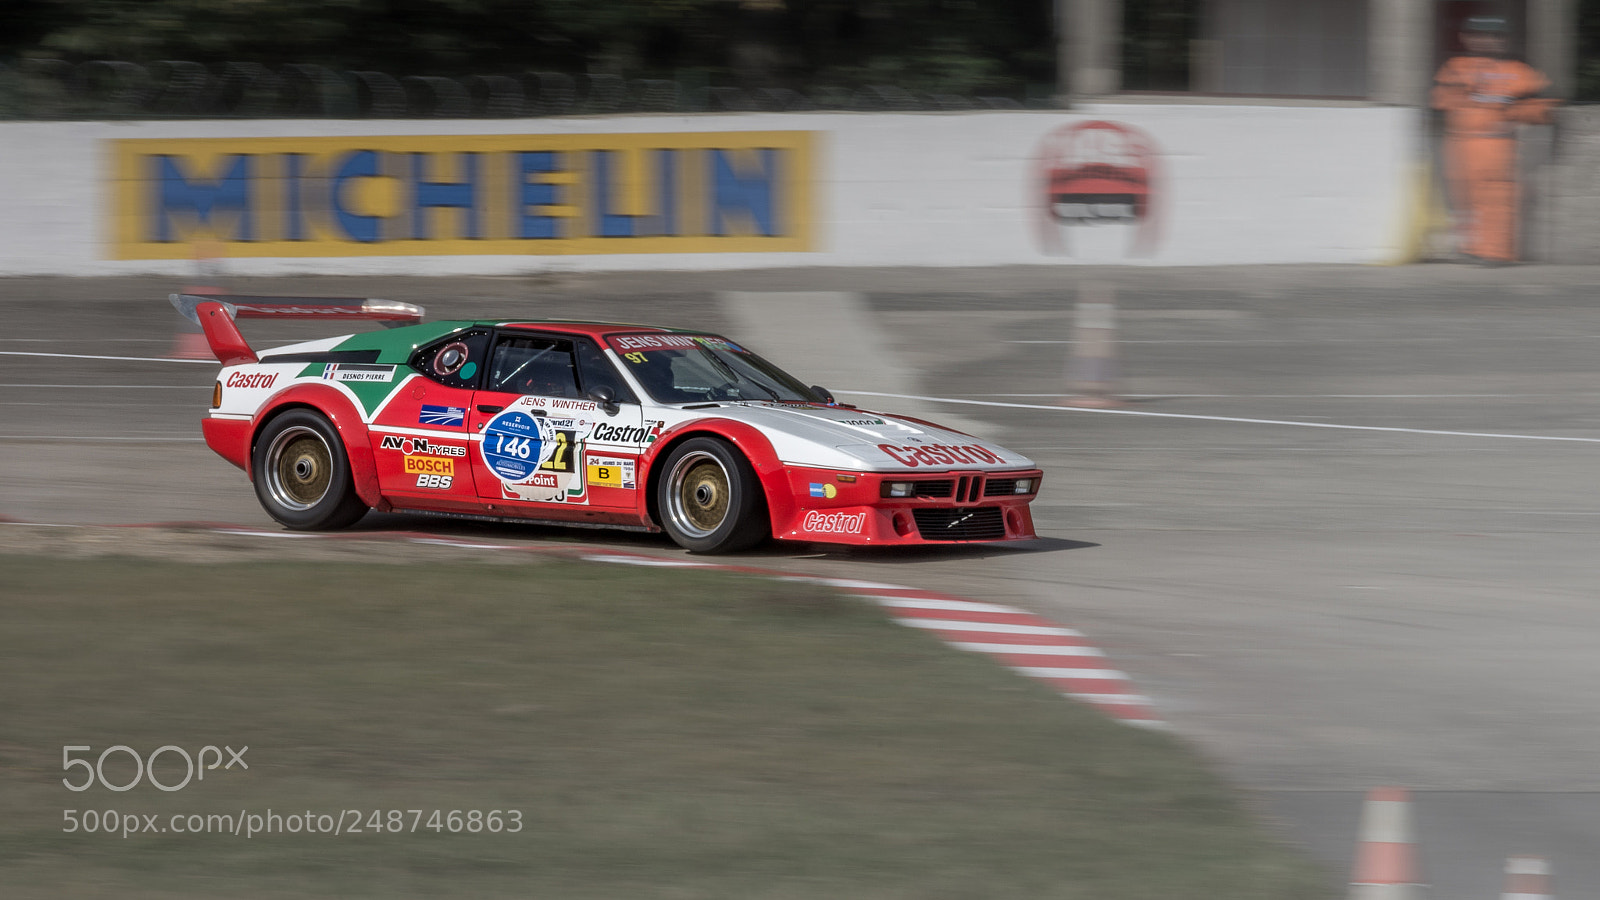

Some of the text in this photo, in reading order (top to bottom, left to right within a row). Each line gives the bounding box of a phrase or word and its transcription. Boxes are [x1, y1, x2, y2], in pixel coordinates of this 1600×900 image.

[145, 148, 787, 244] MICHELIN
[616, 335, 663, 350] JENS
[624, 351, 649, 364] 97
[226, 371, 279, 389] Castrol
[520, 397, 597, 412] JENS WINTHER
[502, 420, 530, 430] RESERVOIR
[593, 423, 652, 443] Castrol
[381, 435, 466, 457] AVON TYRES
[496, 433, 531, 459] 146
[589, 458, 600, 466] 24
[877, 443, 1007, 468] Castrol
[407, 458, 452, 473] BOSCH
[598, 467, 610, 479] B
[416, 473, 453, 489] BBS
[803, 510, 866, 534] Castrol
